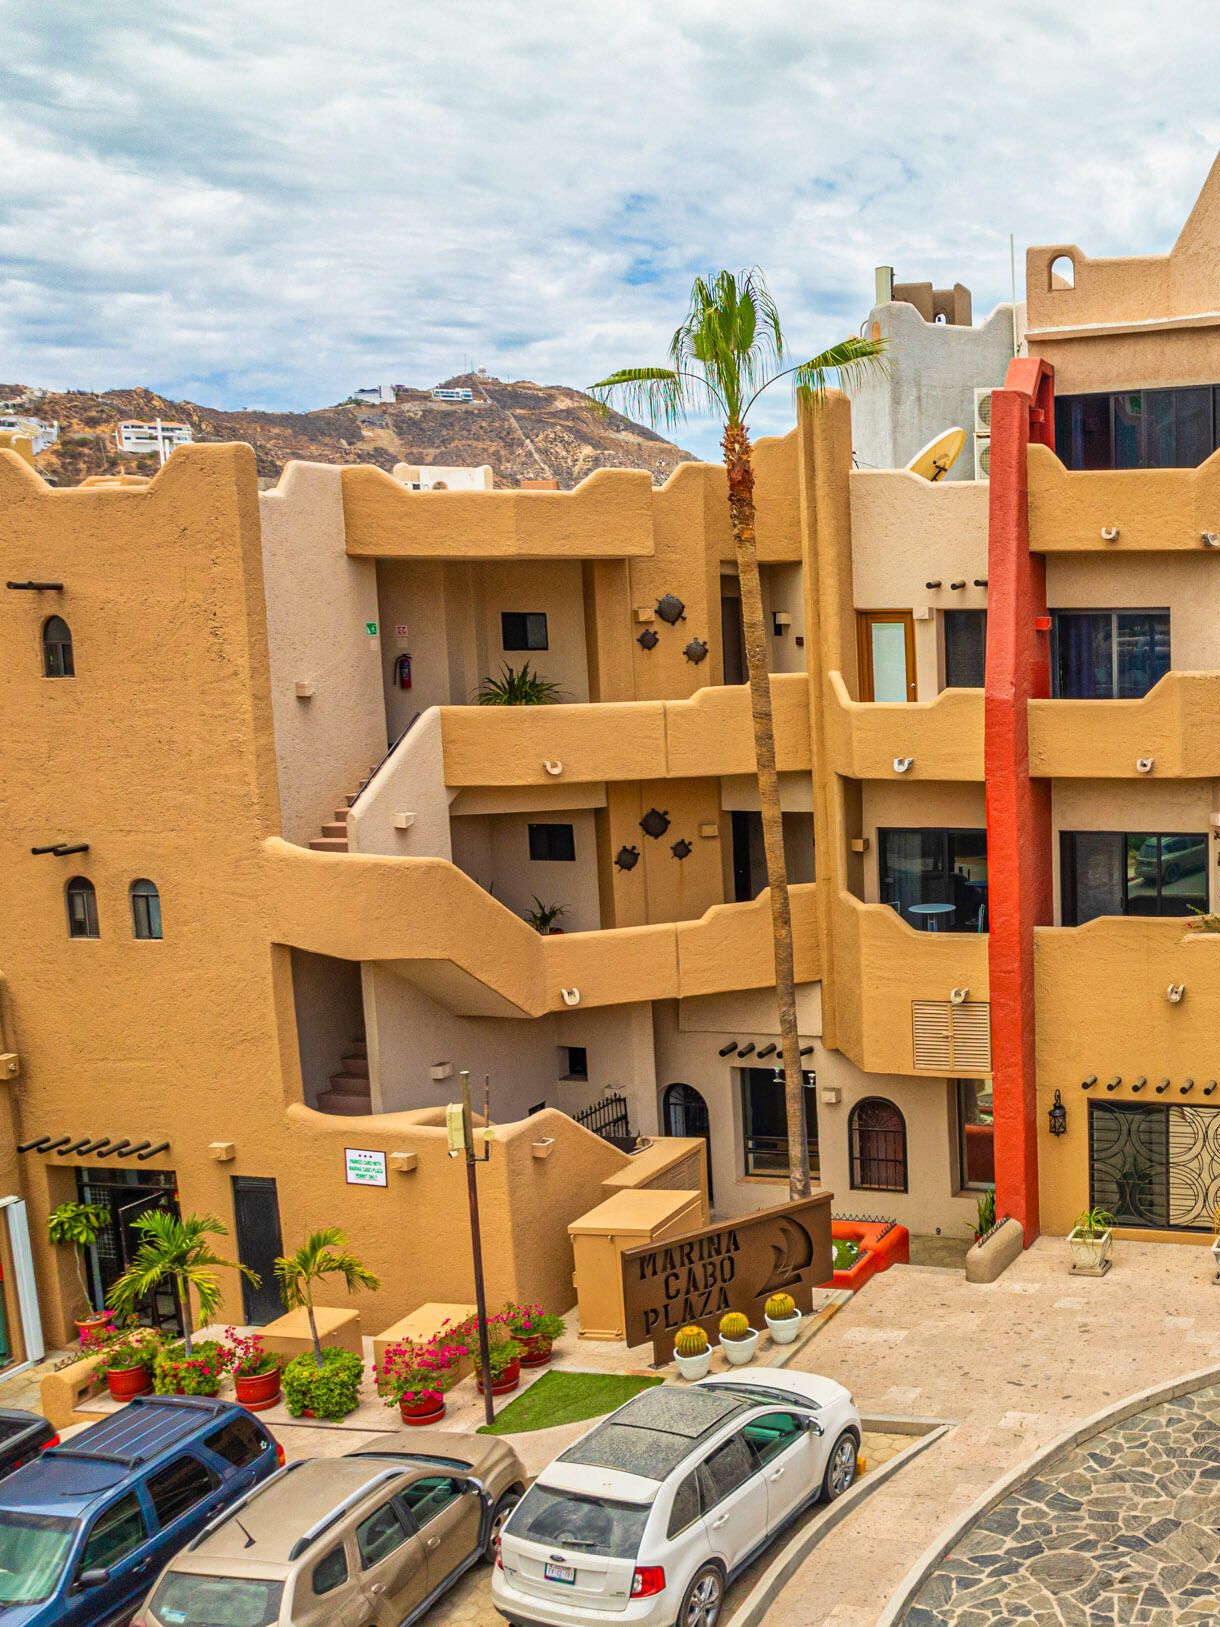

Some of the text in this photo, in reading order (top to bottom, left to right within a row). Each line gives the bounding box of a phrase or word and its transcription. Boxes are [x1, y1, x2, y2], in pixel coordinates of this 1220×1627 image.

[639, 1230, 740, 1281] MARINA
[664, 1256, 735, 1301] CABO
[643, 1287, 731, 1336] PLAZA
